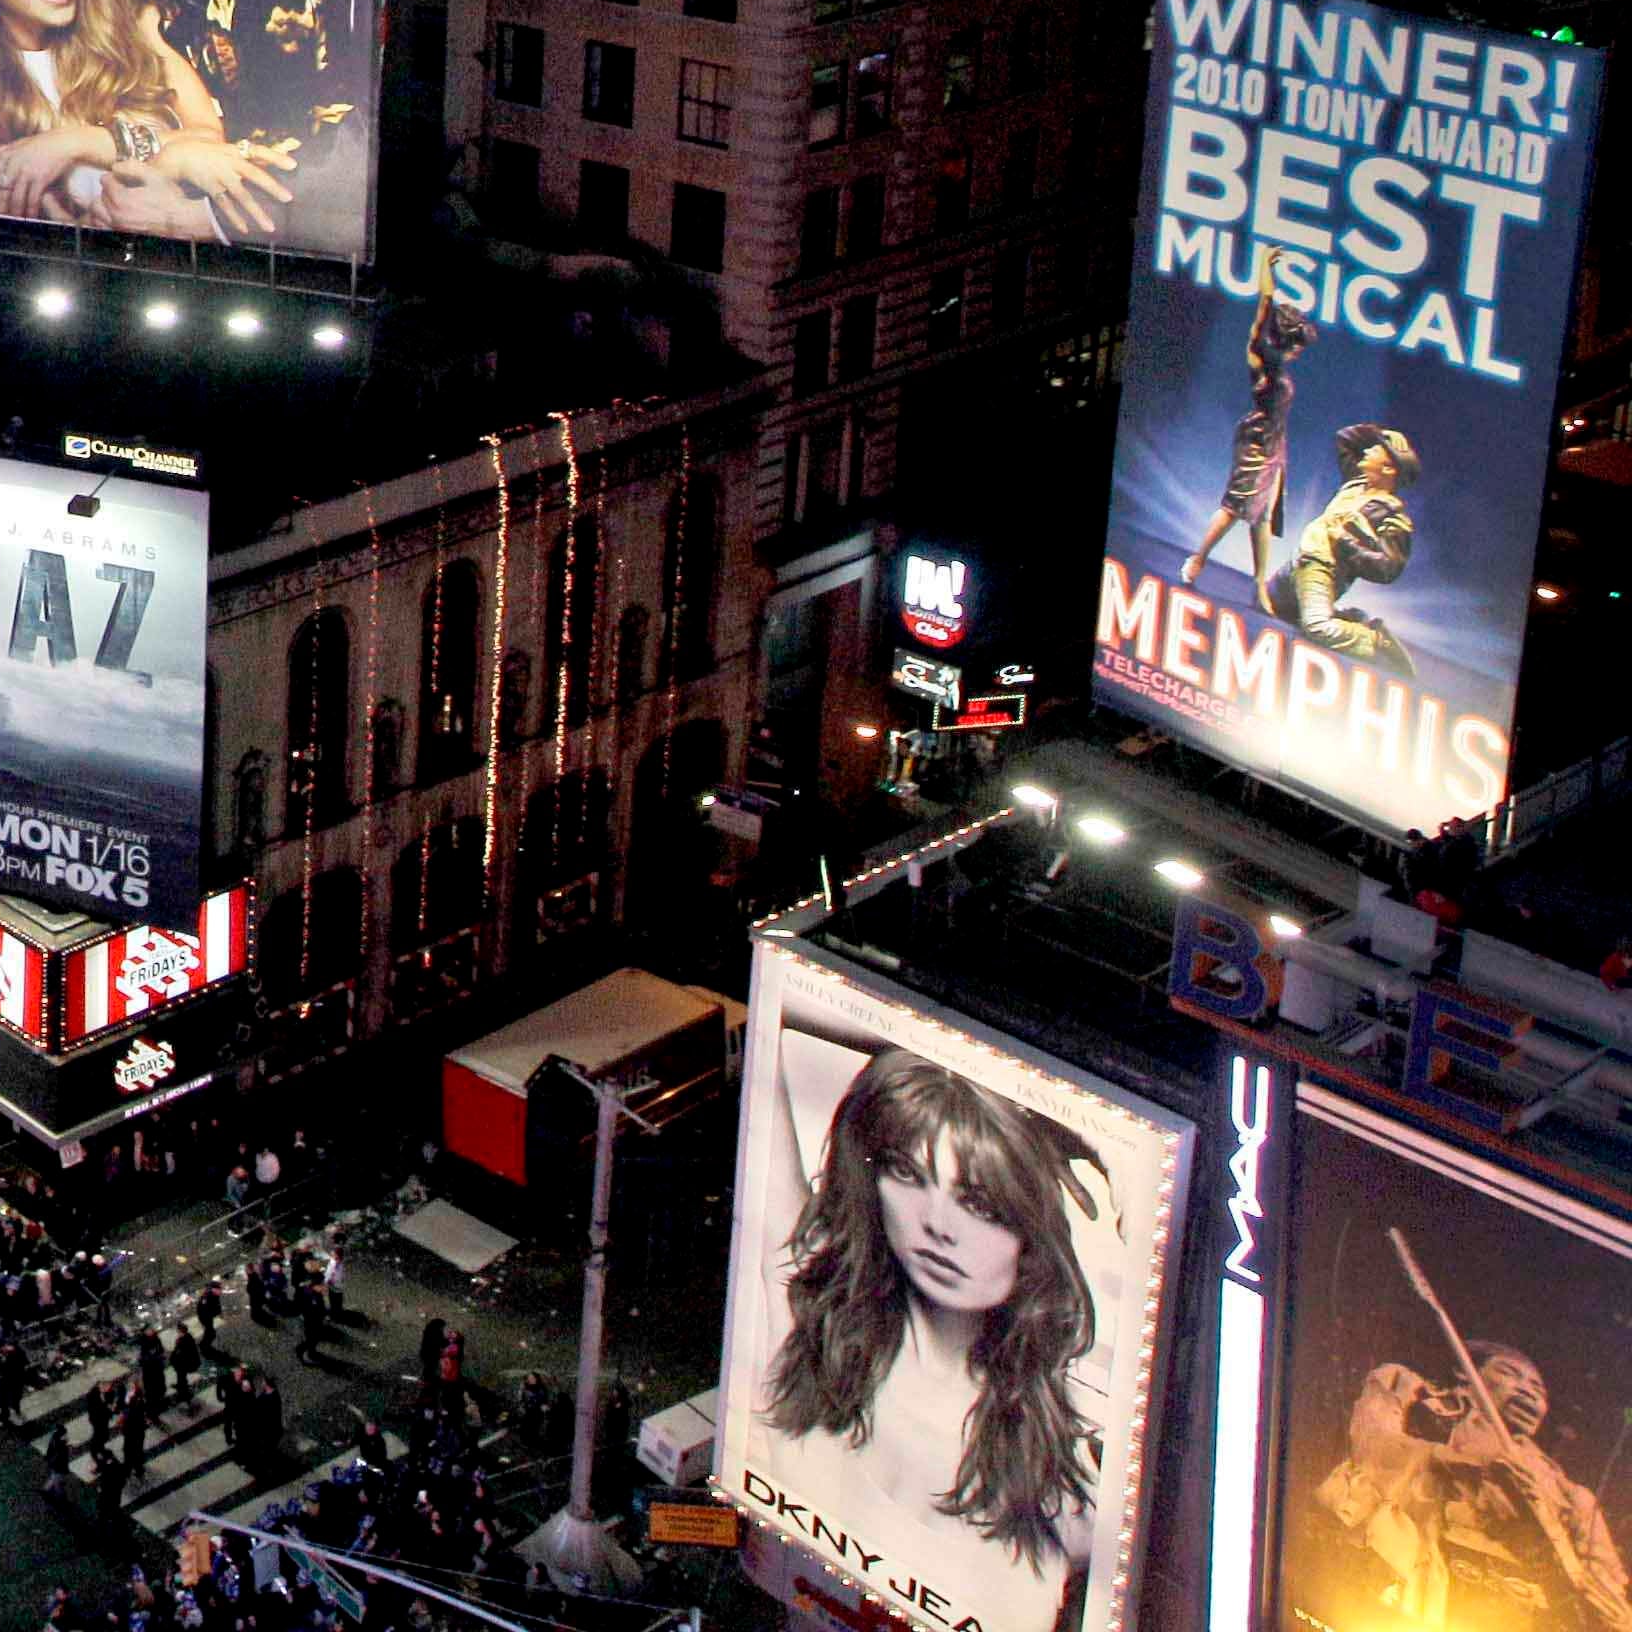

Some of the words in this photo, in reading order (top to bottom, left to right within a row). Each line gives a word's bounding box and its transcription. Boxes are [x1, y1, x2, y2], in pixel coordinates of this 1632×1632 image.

[1173, 51, 1267, 118] 2010
[1281, 76, 1387, 147] TONY
[1397, 105, 1551, 186] AWARD
[1162, 103, 1542, 302] BEST
[1156, 214, 1522, 383] MUSICAL
[42, 528, 159, 561] ABRAMS
[1096, 556, 1512, 813] MEMPHIS
[38, 809, 104, 835] PREMIERE
[107, 826, 151, 845] EVENT
[86, 836, 151, 877] 1/16
[44, 854, 118, 902] FOX
[121, 877, 151, 908] 5
[743, 1470, 884, 1572] DKNY
